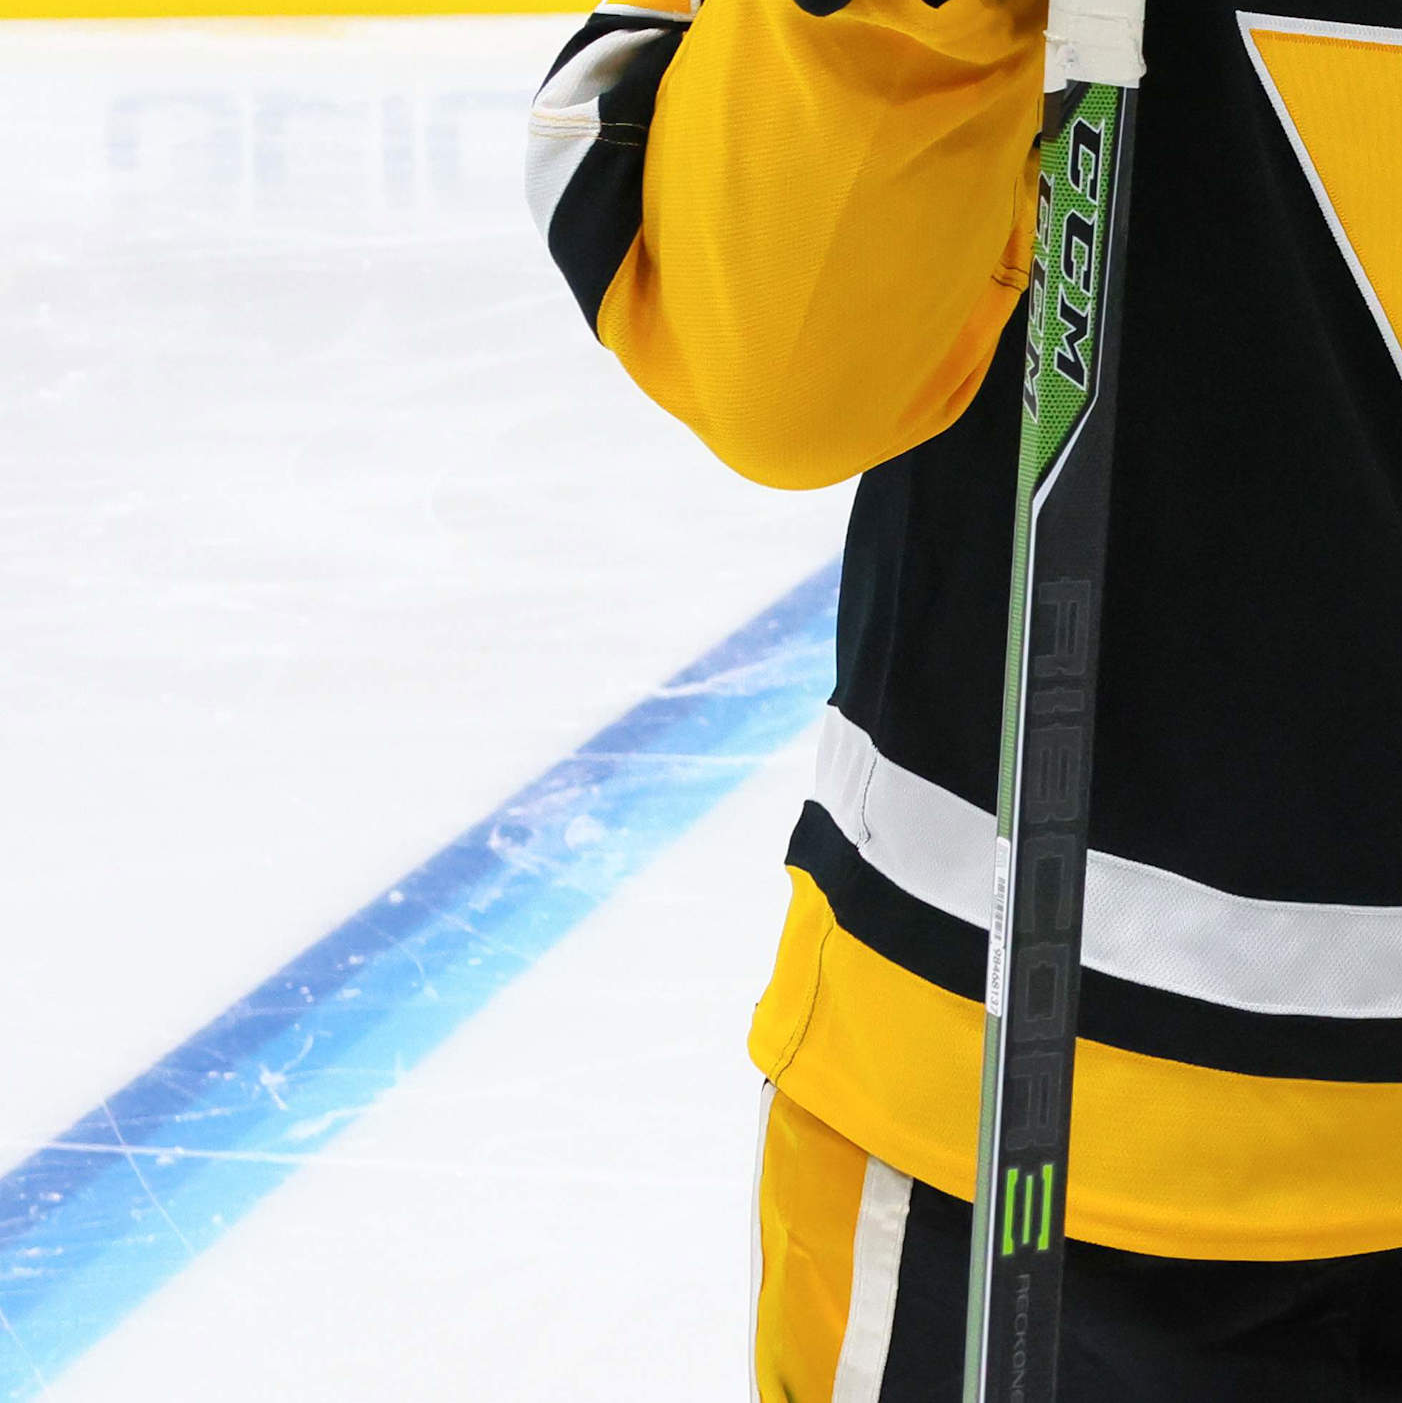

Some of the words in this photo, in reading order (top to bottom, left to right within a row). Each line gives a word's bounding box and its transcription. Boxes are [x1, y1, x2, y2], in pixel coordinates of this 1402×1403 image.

[1022, 169, 1054, 424] CCM
[1053, 115, 1106, 393] CCM
[1004, 577, 1092, 1151] RIBCOR
